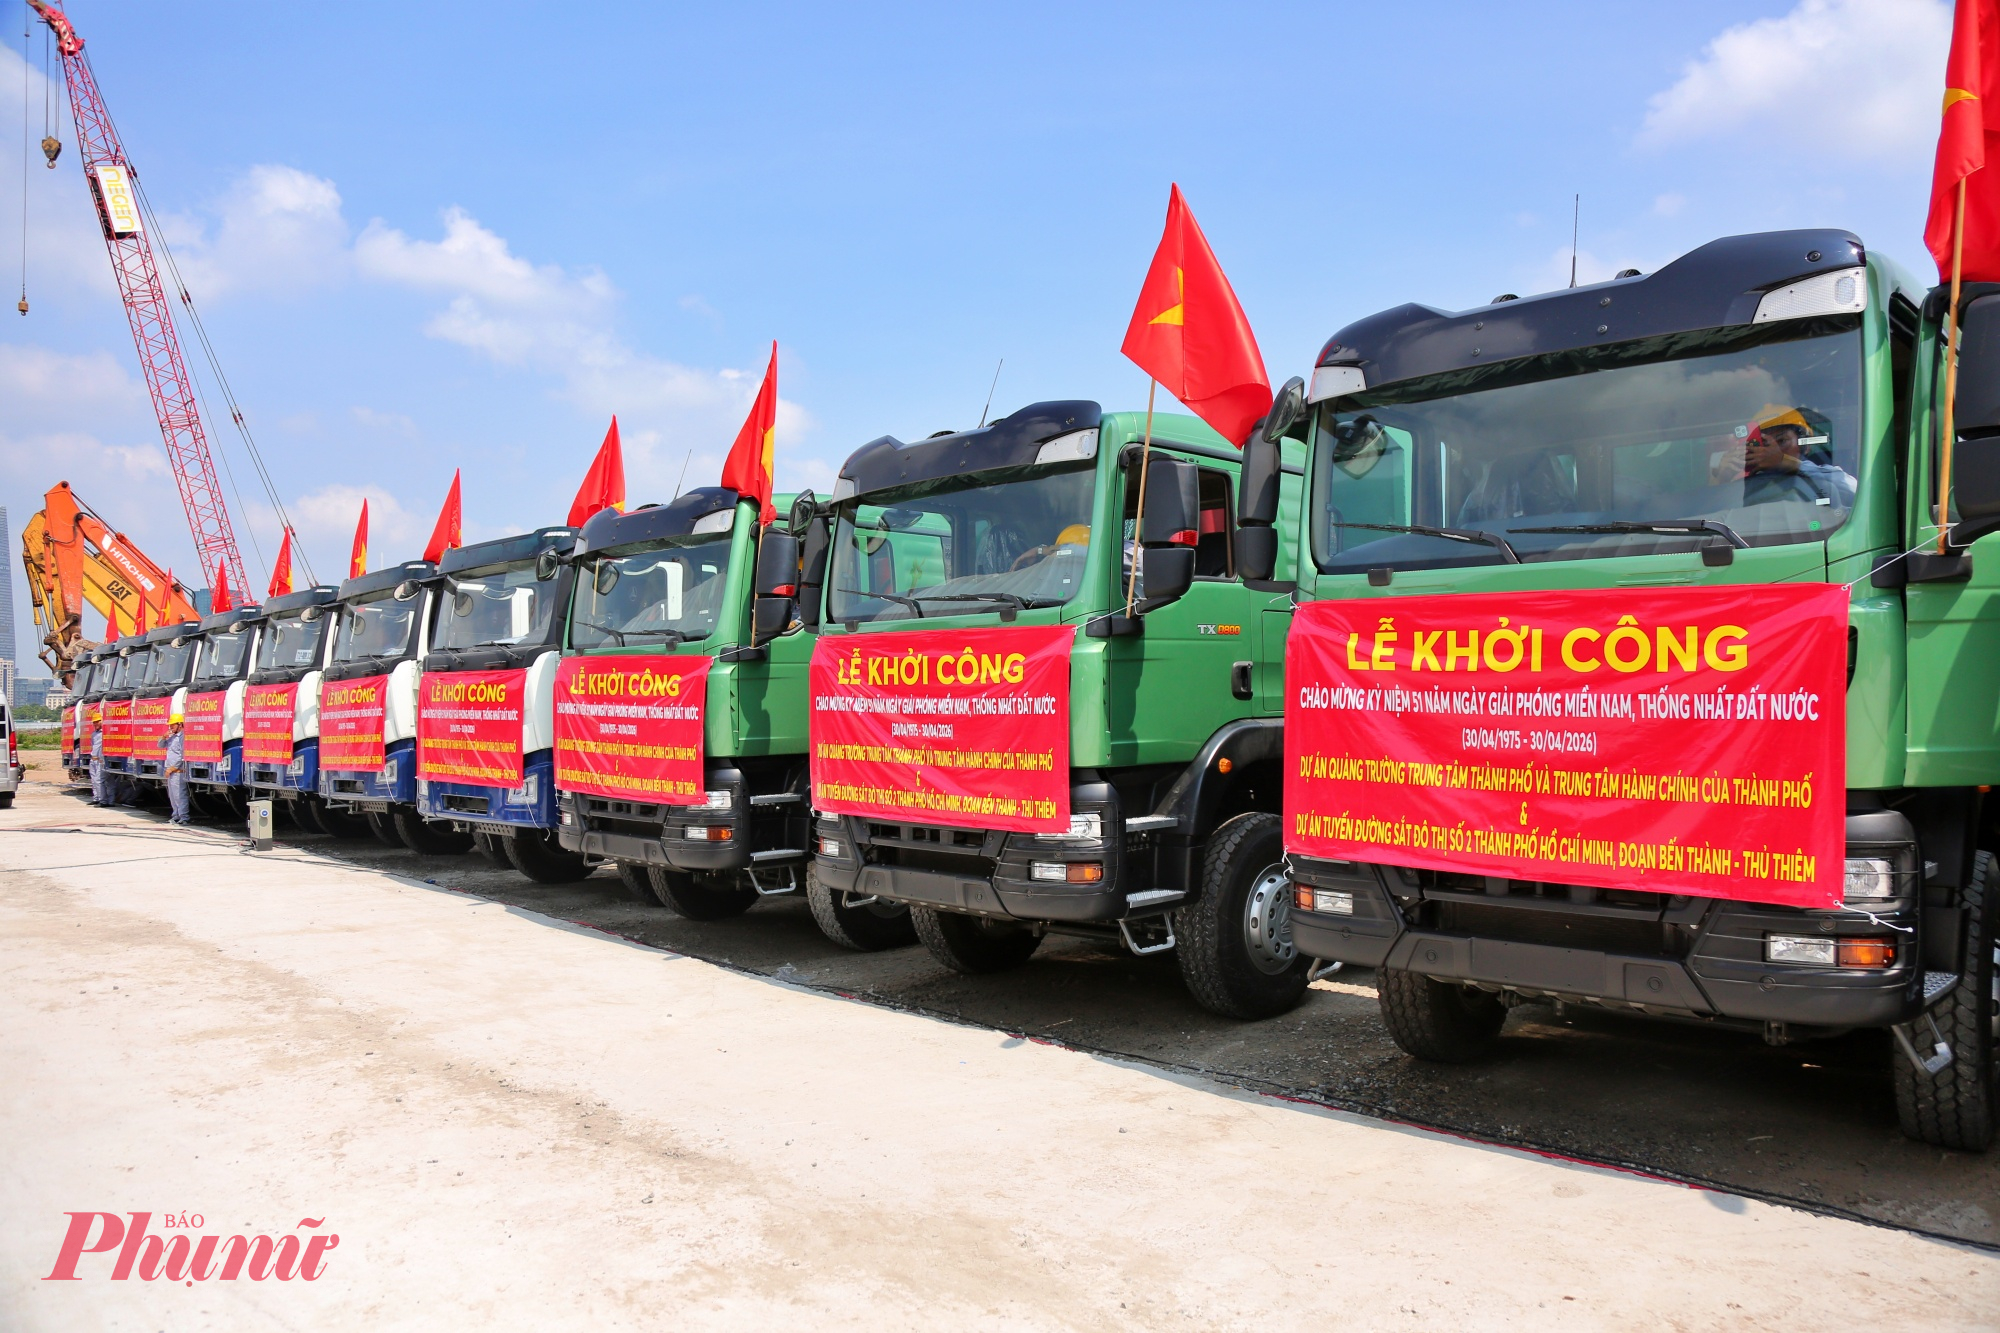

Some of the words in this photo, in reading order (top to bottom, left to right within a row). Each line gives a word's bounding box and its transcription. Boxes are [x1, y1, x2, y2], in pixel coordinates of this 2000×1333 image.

[110, 546, 145, 583] HITACHI
[106, 580, 132, 601] CAT
[1197, 624, 1216, 635] TX
[1347, 617, 1397, 670] LỄ
[1411, 616, 1542, 672] KHỞI
[1561, 615, 1748, 672] CÔNG
[838, 648, 862, 685] LỄ
[868, 647, 928, 686] KHỞI
[936, 646, 1026, 686] CÔNG
[350, 685, 376, 703] CÔNG
[468, 680, 506, 703] CÔNG
[570, 666, 585, 695] LỄ
[588, 668, 624, 696] KHỞI
[628, 668, 681, 697] CÔNG
[816, 693, 828, 711] CHÀO
[915, 694, 937, 715] PHÓNG
[938, 693, 953, 715] MIỀN
[955, 697, 972, 717] NAM,
[972, 692, 997, 715] THỐNG
[998, 692, 1016, 715] NHẤT
[1017, 691, 1032, 715] ĐẤT
[1033, 693, 1056, 715] NƯỚC
[1300, 682, 1329, 709] CHÀO
[1331, 682, 1365, 710] MỪNG
[1366, 683, 1382, 711] KỶ
[1384, 684, 1410, 717] NIỆM
[1412, 691, 1422, 712] 51
[1425, 685, 1450, 713] NĂM
[1453, 686, 1486, 715] NGÀY
[1488, 686, 1513, 716] GIẢI
[1516, 686, 1562, 717] PHÓNG
[1565, 685, 1597, 718] MIỀN
[1600, 693, 1635, 722] NAM,
[1638, 685, 1690, 719] THỐNG
[1693, 685, 1734, 720] NHẤT
[1736, 685, 1766, 720] ĐẤT
[1770, 687, 1819, 721] NƯỚC
[1462, 728, 1521, 750] (30/04/1975
[1530, 730, 1597, 755] 30/04/2026)
[934, 750, 952, 767] TRUNG
[952, 746, 966, 768] TÂM
[966, 747, 982, 769] HÀNH
[984, 748, 1002, 769] CHÍNH
[1003, 748, 1015, 770] CỦA
[1016, 748, 1038, 771] THÀNH
[1039, 747, 1053, 771] PHỐ
[1300, 755, 1312, 783] DỰ
[1313, 753, 1327, 779] ÁN
[1329, 753, 1363, 782] QUẢNG
[1365, 757, 1405, 785] TRƯỜNG
[1408, 763, 1443, 788] TRUNG
[1446, 760, 1467, 789] TÂM
[1471, 761, 1506, 791] THÀNH
[1509, 761, 1534, 794] PHỐ
[1535, 764, 1550, 795] VÀ
[1553, 770, 1591, 797] TRUNG
[1594, 766, 1619, 798] TÂM
[1621, 767, 1655, 800] HÀNH
[1658, 770, 1699, 803] CHÍNH
[1702, 770, 1730, 804] CỦA
[1733, 773, 1778, 807] THÀNH
[1782, 772, 1815, 809] PHỐ
[963, 796, 982, 817] ĐOẠN
[982, 792, 995, 815] BẾN
[995, 794, 1016, 817] THÀNH
[1021, 795, 1033, 818] THỦ
[1035, 797, 1056, 819] THIÊM
[1520, 801, 1528, 825] &
[1296, 813, 1308, 841] DỰ
[1308, 808, 1321, 837] ÁN
[1323, 810, 1352, 840] TUYẾN
[1354, 814, 1392, 845] ĐƯỜNG
[1393, 815, 1412, 846] SẮT
[1413, 819, 1429, 848] ĐÔ
[1431, 826, 1448, 856] THỊ
[1449, 821, 1465, 851] SỐ
[1466, 831, 1472, 852] 2
[1474, 825, 1511, 857] THÀNH
[1514, 827, 1539, 859] PHỐ
[1540, 827, 1557, 860] HỒ
[1559, 833, 1581, 863] CHÍ
[1582, 840, 1616, 870] MINH,
[1619, 842, 1656, 874] ĐOẠN
[1659, 837, 1683, 872] BẾN
[1687, 841, 1731, 876] THÀNH
[1743, 845, 1769, 879] THỦ
[1773, 848, 1815, 883] THIÊM
